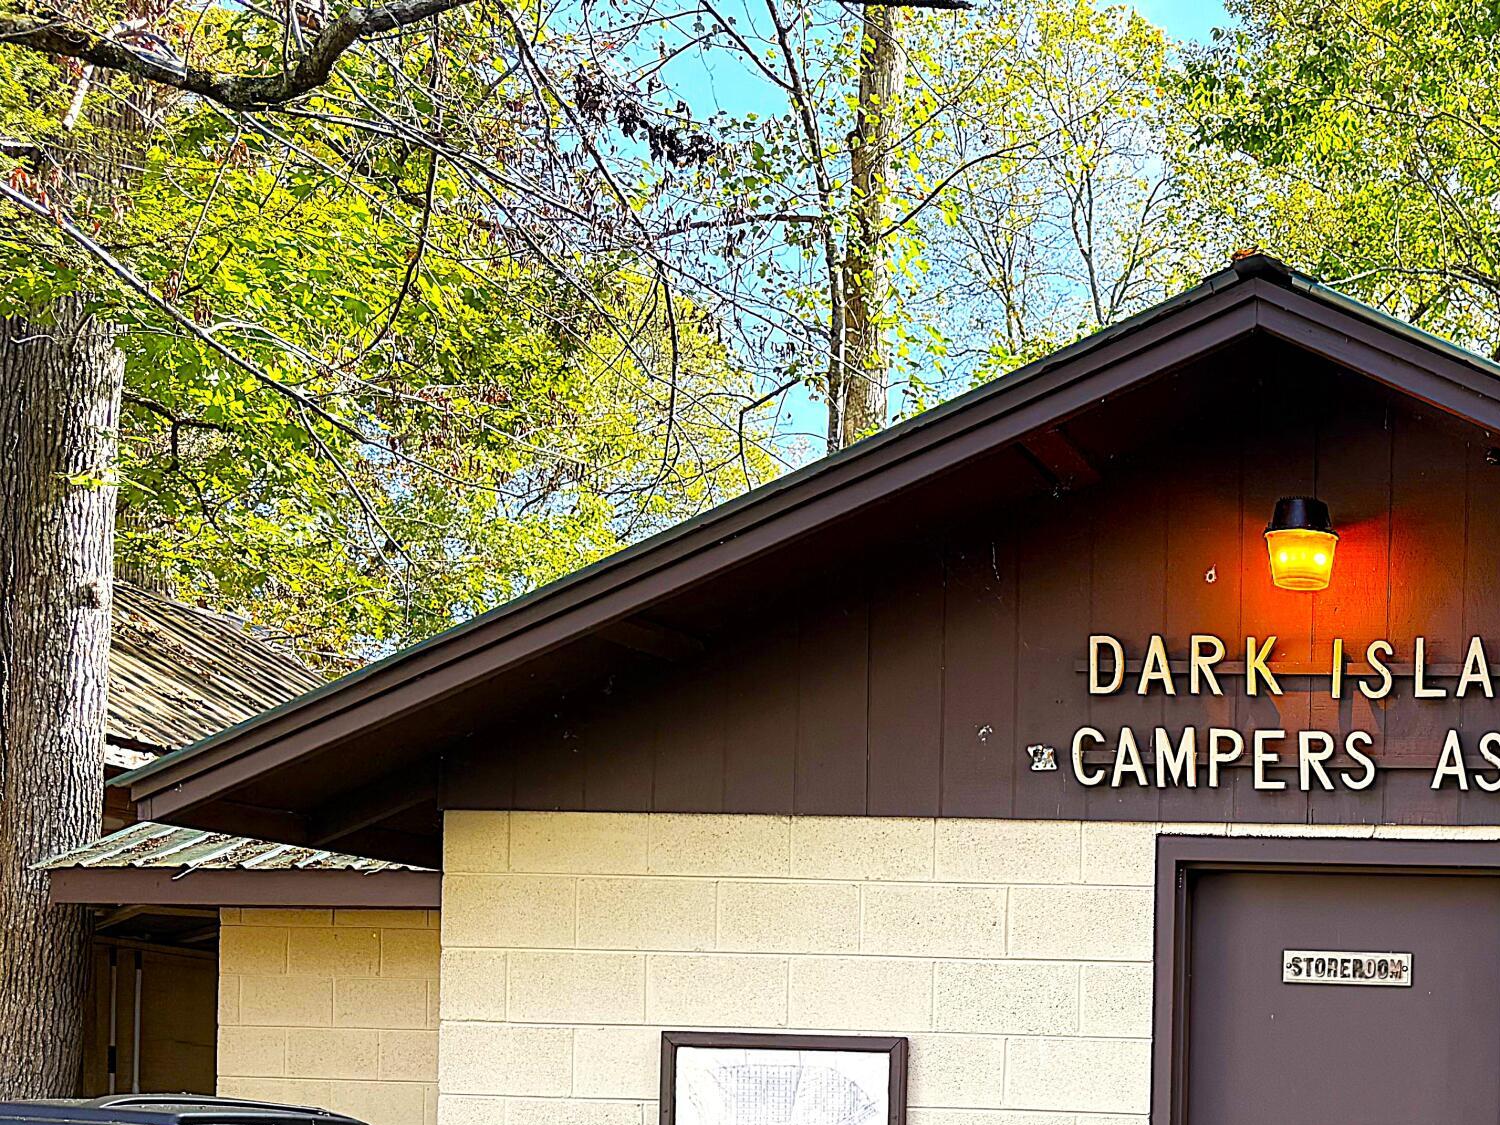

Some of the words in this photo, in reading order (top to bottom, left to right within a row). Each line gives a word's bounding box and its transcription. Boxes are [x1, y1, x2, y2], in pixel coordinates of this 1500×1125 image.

[1087, 634, 1284, 697] DARK
[1070, 726, 1377, 792] CAMPERS
[1291, 956, 1404, 980] STOREROOM
